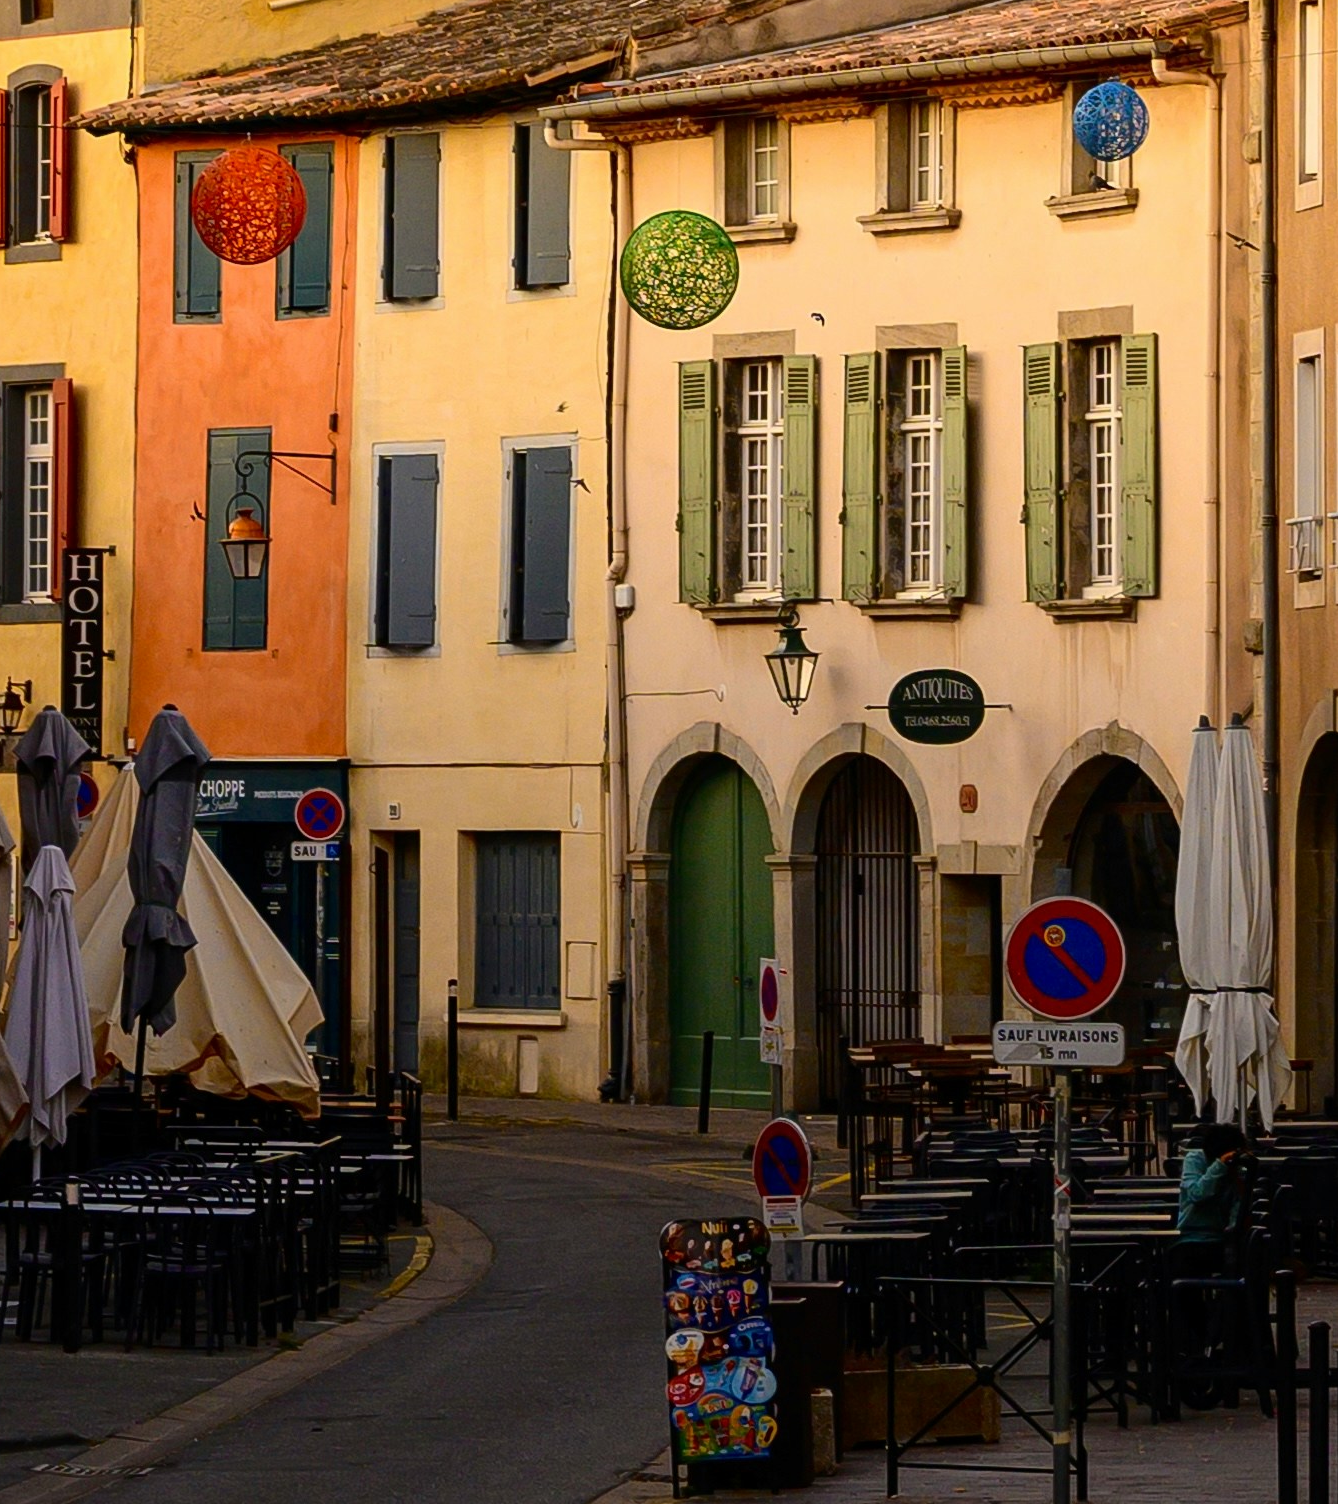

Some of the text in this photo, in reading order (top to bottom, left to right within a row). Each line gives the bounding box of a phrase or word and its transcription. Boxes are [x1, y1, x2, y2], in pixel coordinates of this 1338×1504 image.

[68, 554, 100, 710] HOTEL
[197, 779, 246, 798] CHOPPE
[294, 845, 322, 856] SAU
[997, 1029, 1119, 1043] SAUF LIVRAISONS
[1039, 1047, 1078, 1059] 15 mn
